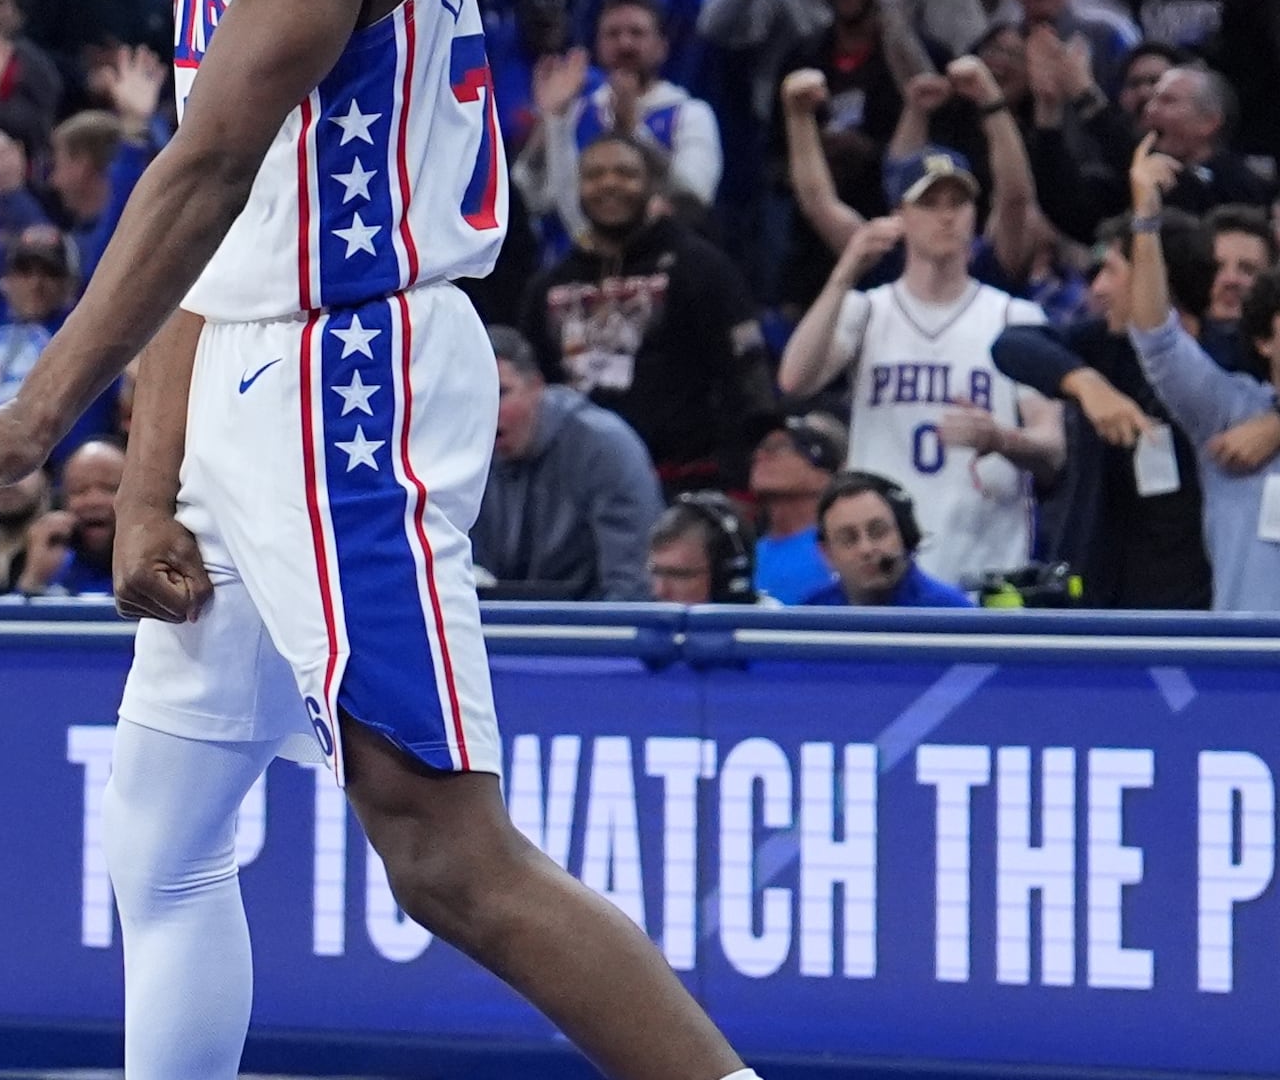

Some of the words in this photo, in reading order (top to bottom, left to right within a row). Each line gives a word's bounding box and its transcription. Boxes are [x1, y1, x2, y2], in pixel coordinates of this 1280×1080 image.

[449, 32, 500, 231] 7
[870, 363, 993, 412] PHILA
[913, 423, 946, 474] 0
[915, 743, 1155, 990] THE
